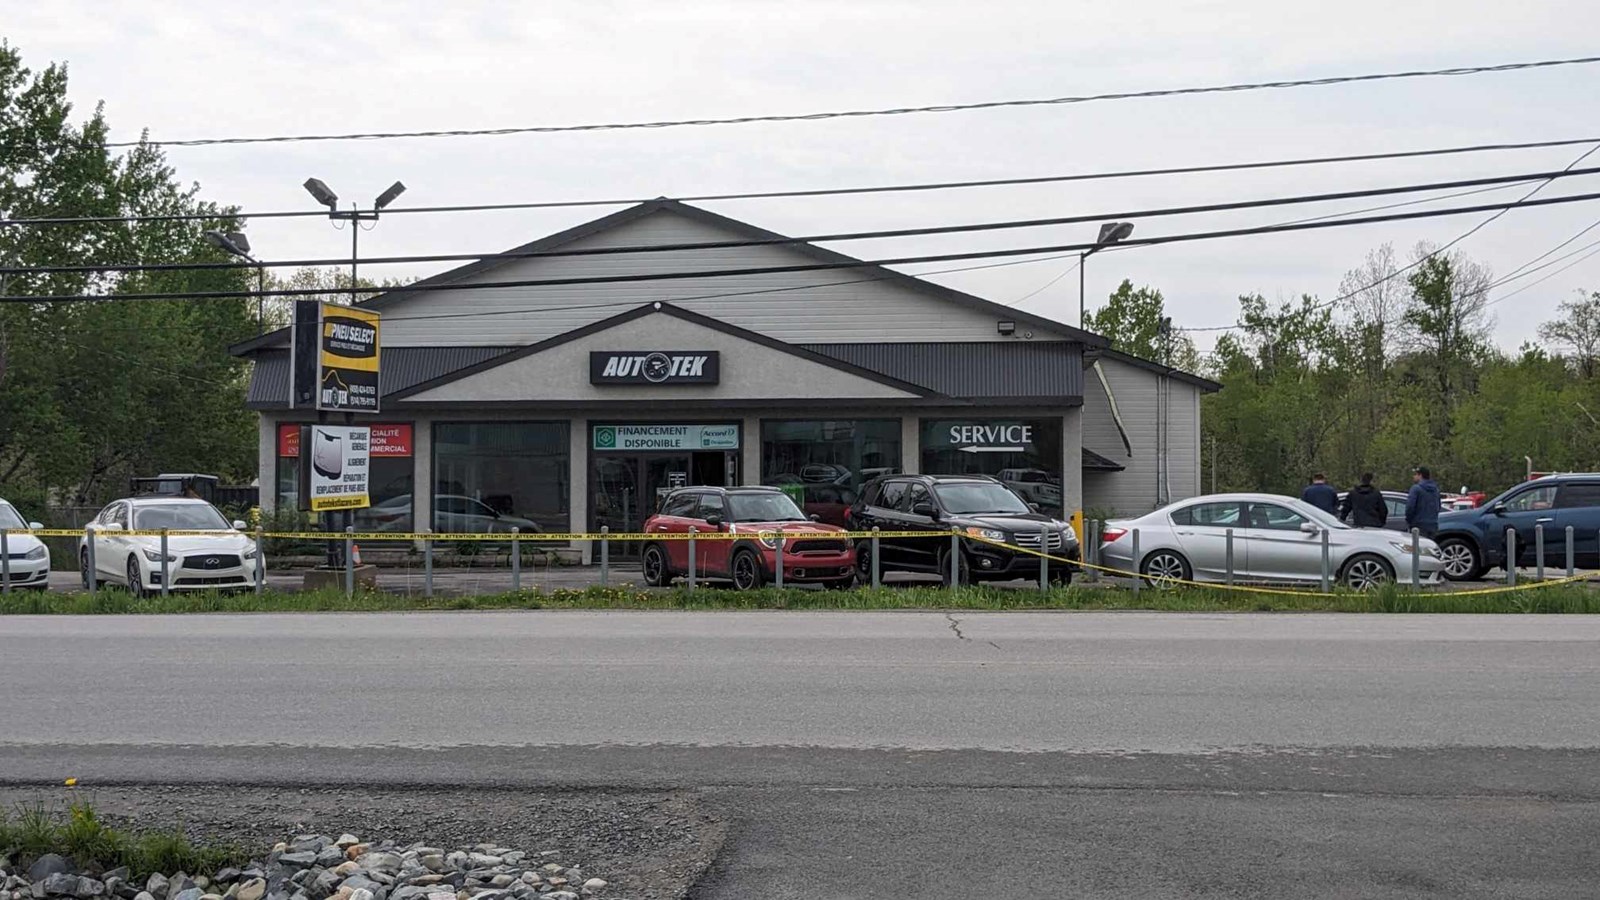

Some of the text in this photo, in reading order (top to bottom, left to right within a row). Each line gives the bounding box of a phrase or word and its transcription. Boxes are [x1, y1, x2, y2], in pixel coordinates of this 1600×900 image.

[371, 429, 400, 437] CIALITÉ
[617, 426, 688, 436] FINANCEMENT
[950, 425, 1032, 443] SERVICE
[624, 438, 681, 448] DISPONIBLE
